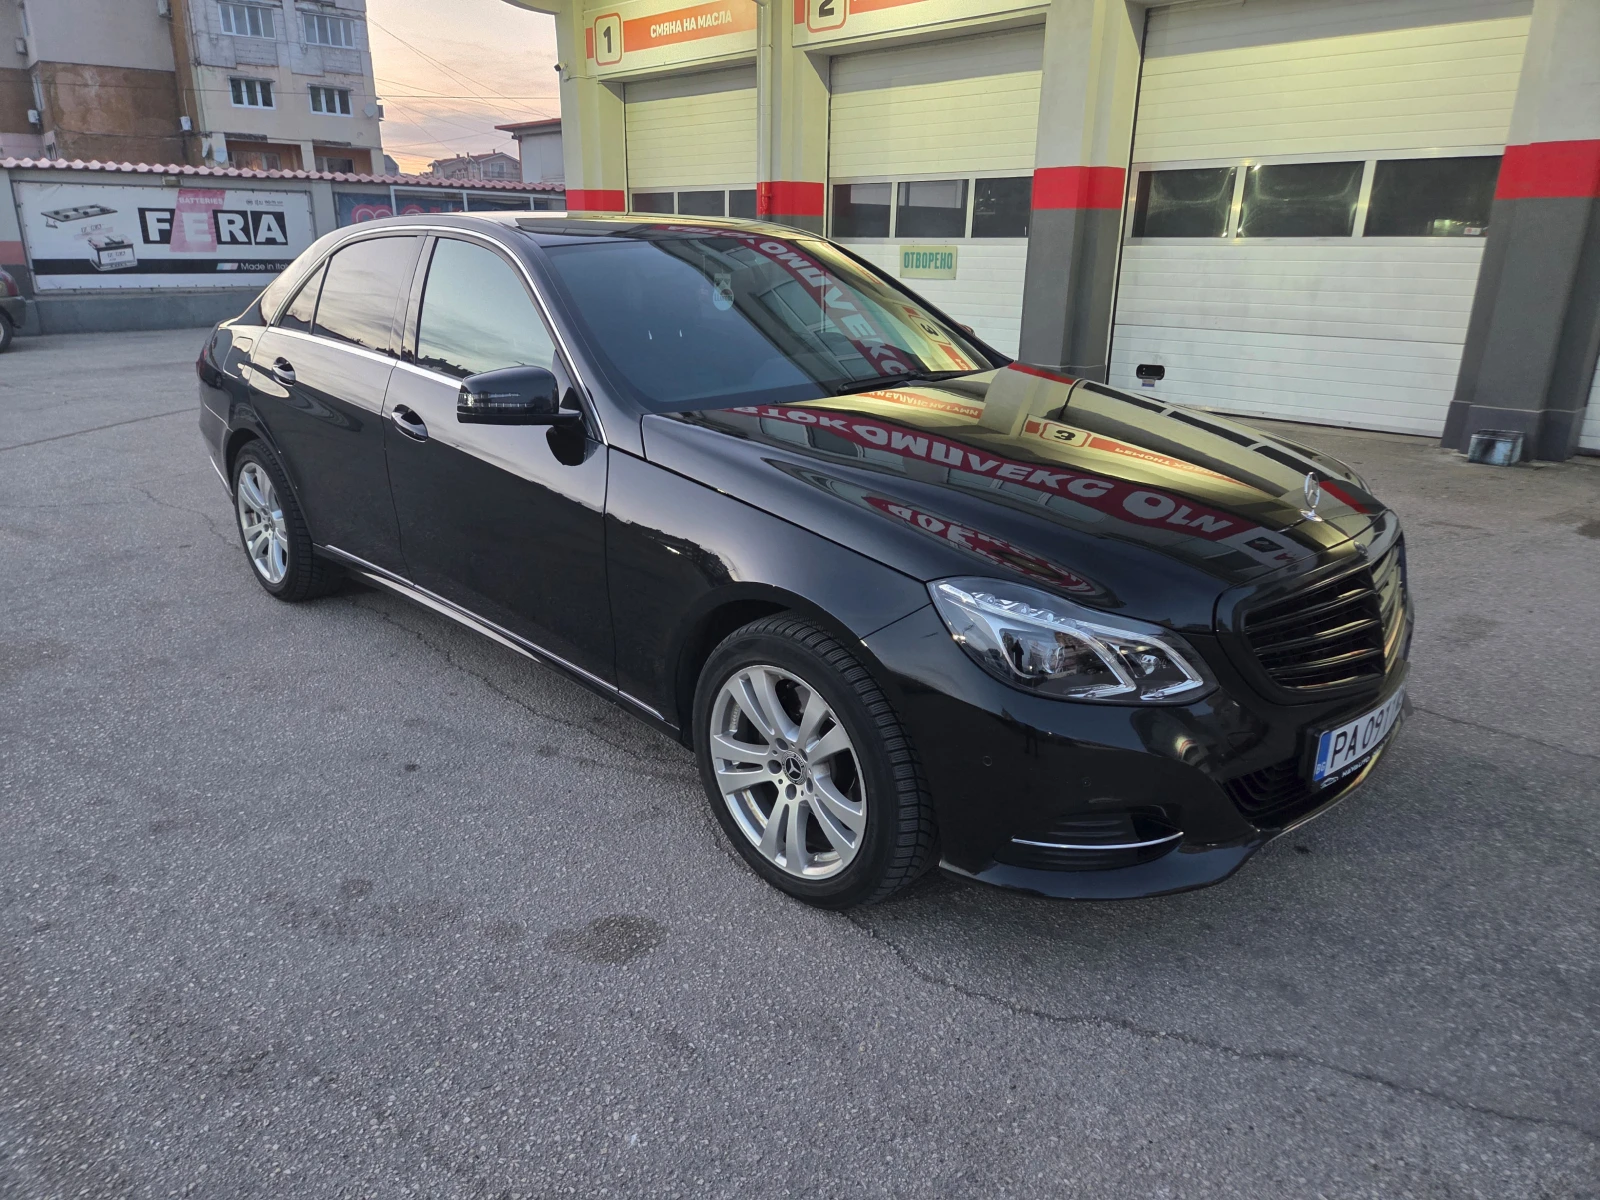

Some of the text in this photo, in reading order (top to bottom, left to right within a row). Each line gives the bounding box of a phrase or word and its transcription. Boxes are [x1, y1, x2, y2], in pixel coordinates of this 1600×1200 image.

[650, 9, 733, 38] СМЯНА НА МАСЛА
[603, 25, 612, 54] 1
[179, 195, 224, 206] BATTERIES
[145, 210, 287, 243] FERA
[240, 262, 266, 271] Made
[267, 262, 275, 271] in
[903, 251, 953, 270] ОТВОРЕНО
[1330, 724, 1359, 769] PA
[1315, 761, 1327, 775] BG
